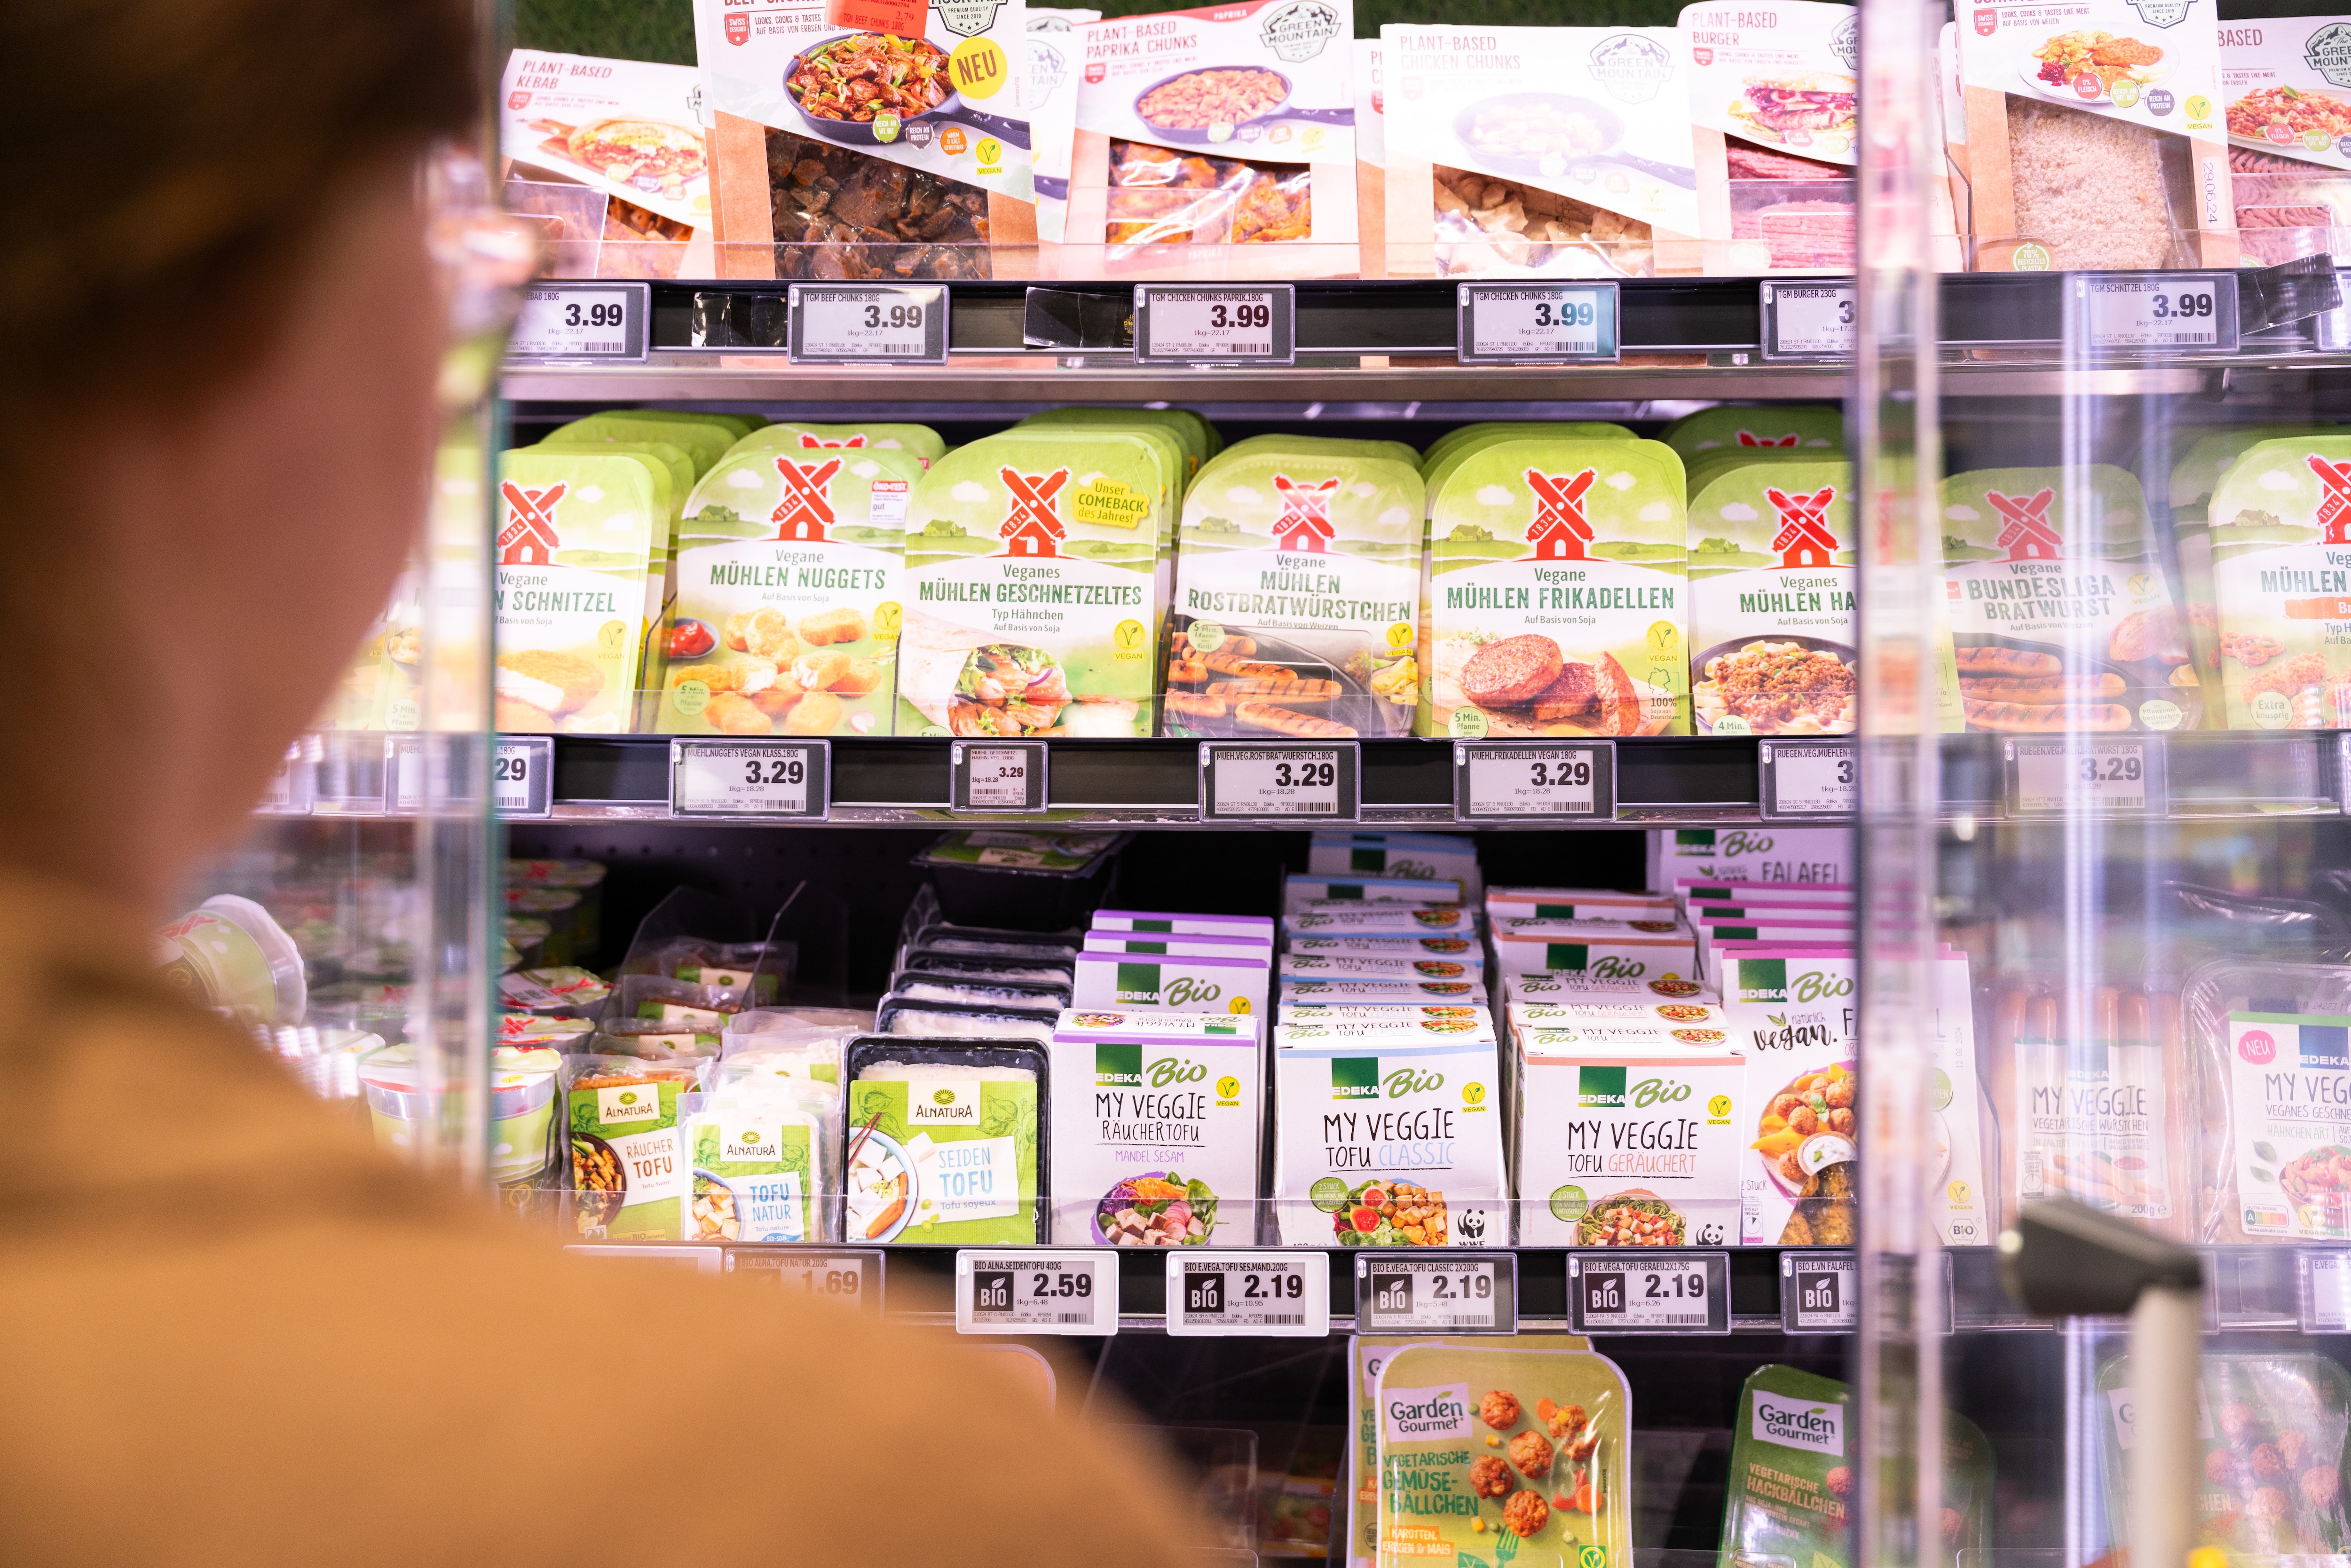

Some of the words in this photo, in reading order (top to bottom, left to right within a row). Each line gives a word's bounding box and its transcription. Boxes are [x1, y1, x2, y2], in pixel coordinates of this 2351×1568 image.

[844, 13, 853, 22] TGM
[855, 15, 868, 24] BEEF
[871, 18, 889, 28] CHUNKS
[892, 21, 904, 31] 180G
[896, 10, 914, 21] 2,79
[1087, 21, 1176, 42] PLANT-BASED
[1269, 25, 1333, 44] MOUNTAIN
[1279, 20, 1322, 33] GREEN
[1087, 40, 1140, 58] PAPRIKA
[1148, 35, 1197, 53] CHUNKS
[1401, 36, 1496, 51] PLANT-BASED
[1693, 31, 1740, 46] BURGER
[522, 60, 612, 78] PLANT-BASED
[957, 49, 997, 85] NEU
[1401, 54, 1459, 70] CHICKEN
[1467, 54, 1521, 70] CHUNKS
[517, 76, 559, 89] KEBAB
[2203, 162, 2217, 224] 29.06.24
[1152, 293, 1166, 302] TGM
[1168, 293, 1195, 302] CHICKEN
[1197, 293, 1222, 302] CHUNKS
[1223, 293, 1263, 302] PAPRIK.180G
[2091, 284, 2105, 293] TGM
[2107, 284, 2142, 293] SCHNITZEL
[2144, 283, 2159, 292] 180G
[565, 303, 623, 327] 3.99
[1535, 303, 1594, 326] 3.99
[2153, 294, 2212, 317] 3.99
[865, 305, 922, 328] 3.99
[1211, 305, 1269, 328] 3.99
[1095, 482, 1125, 494] Unser
[873, 502, 884, 512] gut
[1079, 494, 1144, 512] COMEBACK
[1078, 506, 1095, 518] des
[1097, 509, 1133, 523] Jahres!
[1531, 513, 1554, 537] 1834
[776, 549, 824, 565] Vegane
[1276, 554, 1325, 569] Vegane
[710, 561, 788, 586] MÜHLEN
[798, 568, 885, 589] NUGGETS
[1003, 564, 1060, 581] Veganes
[1535, 568, 1586, 585] Vegane
[2010, 564, 2061, 576] Vegane
[2261, 566, 2347, 593] MÜHLEN
[920, 577, 991, 602] MÜHLEN
[997, 583, 1141, 605] GESCHNETZELTES
[1261, 568, 1340, 594] MÜHLEN
[1780, 576, 1838, 591] Veganes
[1967, 575, 2116, 600] BUNDESLIGA
[513, 591, 616, 612] SCHNITZEL
[1189, 588, 1410, 621] ROSTBRATWÜRSTCHEN
[1447, 583, 1529, 609] MÜHLEN
[1539, 587, 1674, 609] FRIKADELLEN
[1740, 590, 1822, 612] MÜHLEN
[992, 609, 1009, 622] Typ
[1011, 609, 1063, 620] Hähnchen
[1984, 598, 2109, 620] BRATWURST
[1524, 615, 1538, 624] Auf
[1540, 615, 1561, 624] Basis
[1578, 615, 1596, 626] Soja
[1650, 698, 1677, 707] 100%
[2258, 700, 2284, 710] Extra
[2256, 711, 2288, 720] knusprig
[688, 749, 739, 757] MUEHL.NUGGETS
[740, 749, 761, 757] VEGAN
[1472, 751, 1536, 760] MUEHL.FRIKADELLEN
[746, 761, 804, 784] 3.29
[999, 767, 1023, 777] 3.29
[1276, 763, 1334, 786] 3.29
[1531, 763, 1590, 786] 3.29
[2081, 757, 2141, 781] 3.29
[1741, 990, 1787, 998] EDEKA
[1792, 972, 1854, 1003] Bio
[1791, 1011, 1825, 1024] natürlich
[1753, 1024, 1837, 1050] vegan.
[2246, 1040, 2270, 1056] NEU
[1097, 1073, 1142, 1082] EDEKA
[1146, 1057, 1207, 1087] Bio
[1333, 1086, 1379, 1095] EDEKA
[1382, 1068, 1444, 1098] Bio
[606, 1103, 653, 1118] ALNATURA
[1096, 1093, 1123, 1119] MY
[1132, 1094, 1206, 1120] VEGGIE
[2032, 1087, 2062, 1115] MY
[2071, 1085, 2147, 1116] VEGGIE
[916, 1105, 972, 1118] ALNATURA
[1103, 1120, 1199, 1142] RÄUCHERTOFU
[1324, 1112, 1356, 1143] MY
[1366, 1108, 1454, 1141] VEGGIE
[1568, 1120, 1602, 1150] MY
[1611, 1119, 1698, 1150] VEGGIE
[627, 1139, 673, 1158] RÄUCHER
[727, 1144, 775, 1156] ALNATURA
[939, 1146, 990, 1168] SEIDEN
[1116, 1150, 1150, 1162] MANDEL
[1153, 1151, 1184, 1163] SESAM
[1325, 1147, 1371, 1167] TOFU
[1379, 1143, 1454, 1166] CLASSIC
[633, 1157, 672, 1178] TOFU
[1568, 1155, 1602, 1172] TOFU
[1609, 1152, 1696, 1173] GERÄUCHERT
[749, 1183, 789, 1203] TOFU
[939, 1170, 993, 1198] TOFU
[752, 1205, 791, 1221] NATUR
[963, 1199, 996, 1207] soyeux
[2131, 1204, 2154, 1216] 200g
[987, 1261, 1044, 1270] ALNA.SEIDENTOFU
[1373, 1264, 1384, 1272] BIO
[1386, 1264, 1426, 1272] E.VEGA.TOFU
[802, 1270, 858, 1295] 1.69
[1033, 1273, 1091, 1297] 2.59
[1244, 1275, 1302, 1298] 2.19
[1433, 1275, 1491, 1299] 2.19
[1645, 1274, 1704, 1298] 2.19
[1390, 1399, 1462, 1421] Garden
[1759, 1404, 1835, 1434] Garden
[1399, 1418, 1459, 1432] Gourmet
[1766, 1422, 1829, 1445] Gourmet
[1383, 1451, 1469, 1467] VEGETARISCHE
[1382, 1469, 1458, 1492] GEMÜSE-
[1750, 1462, 1819, 1493] VEGETARISCHE
[1390, 1493, 1479, 1516] BÄLLCHEN
[1747, 1475, 1845, 1519] HACKBÄLLCHEN
